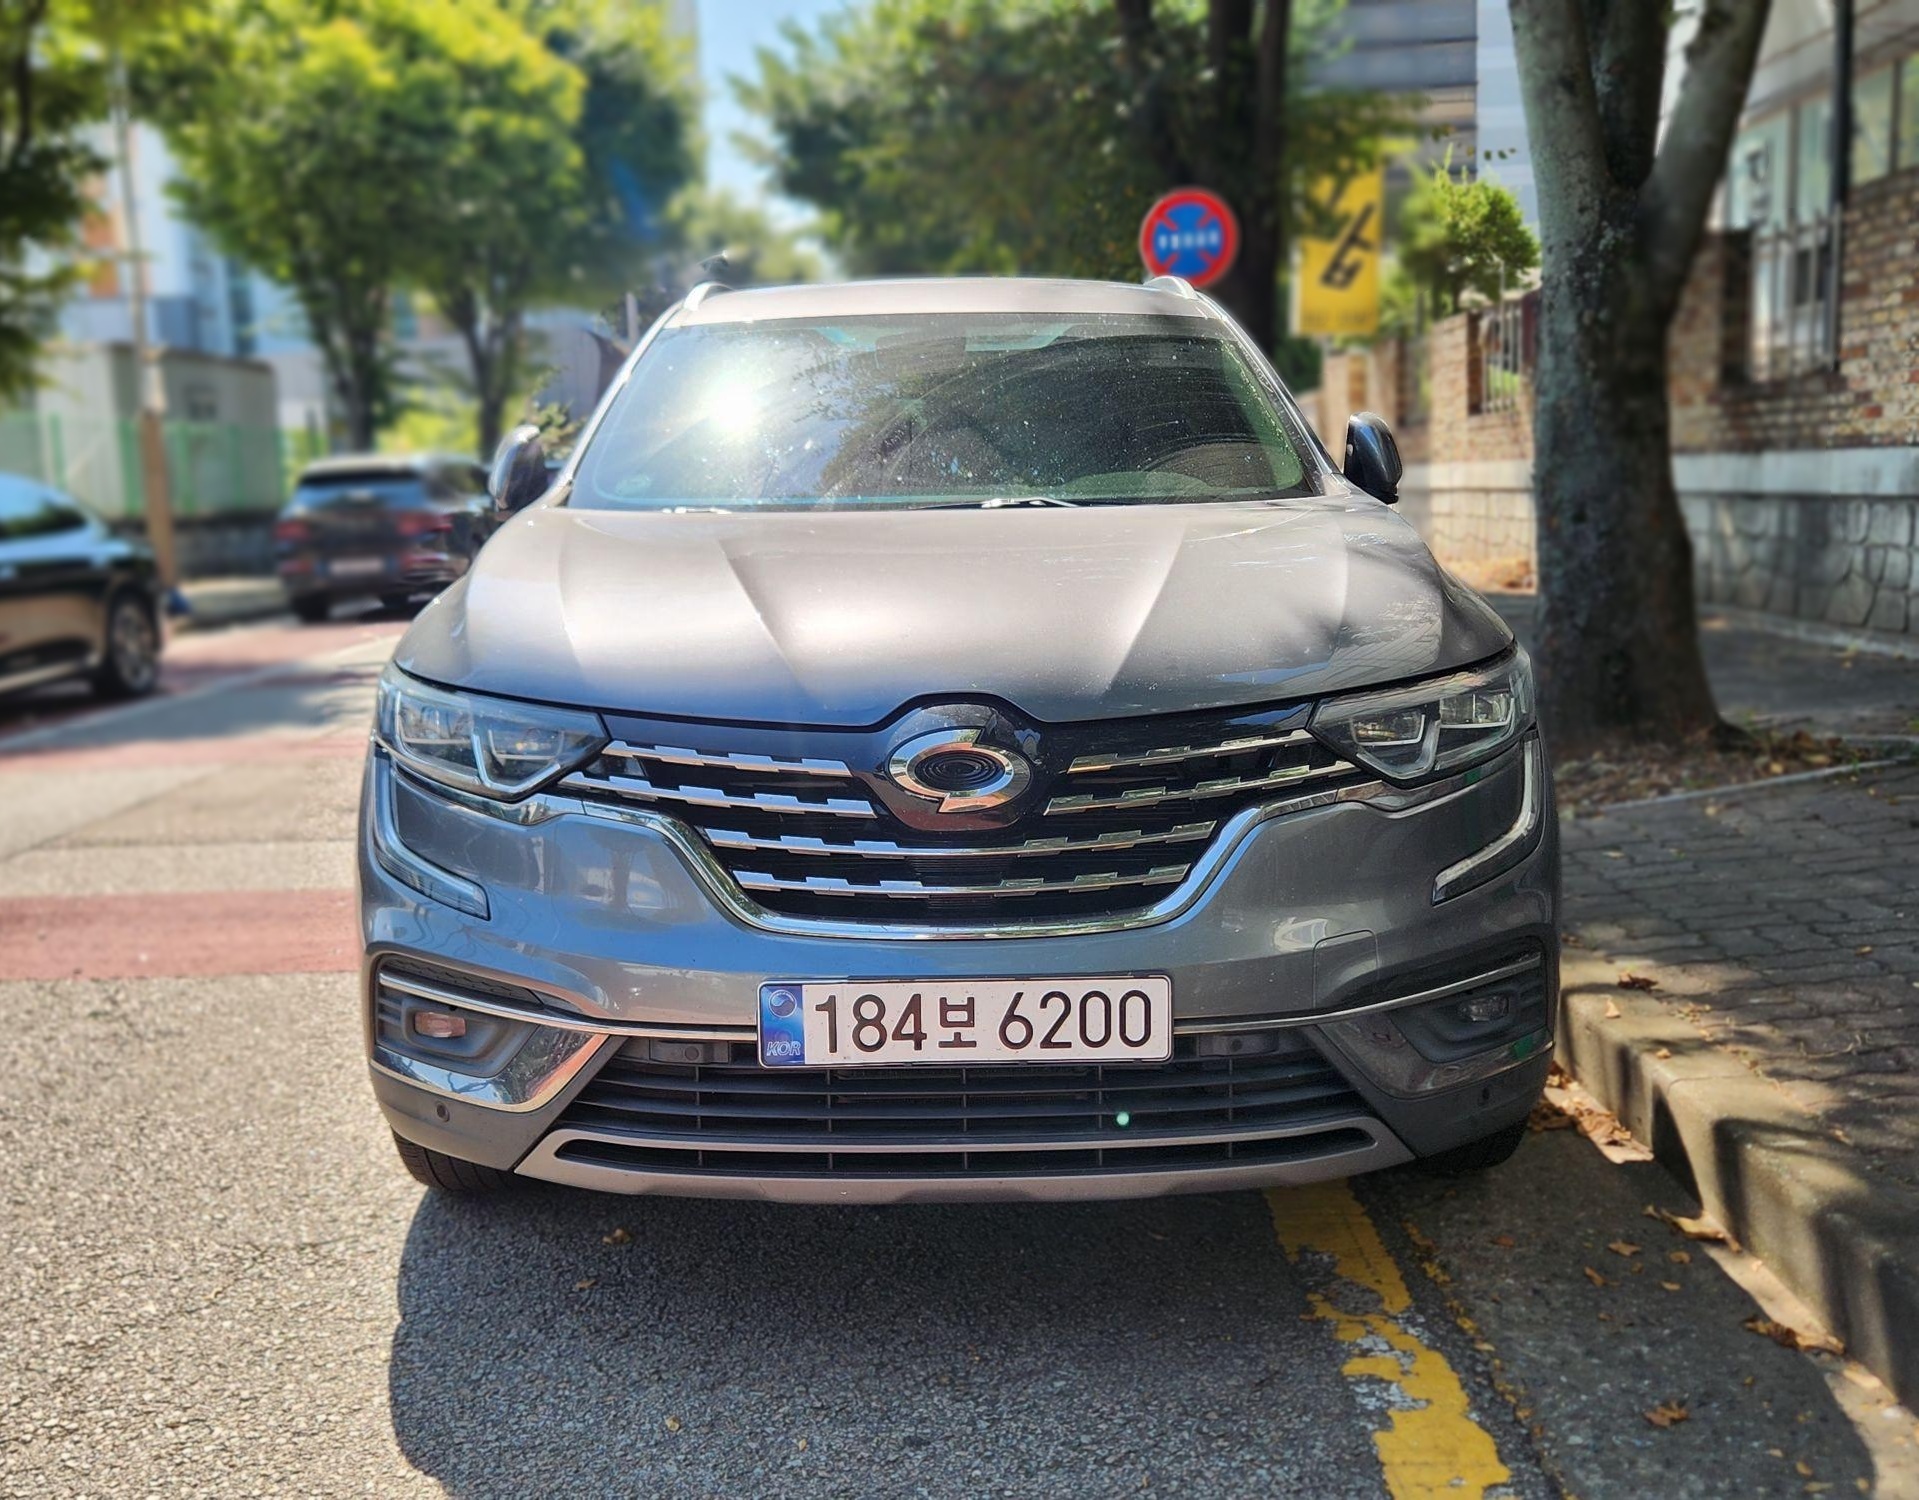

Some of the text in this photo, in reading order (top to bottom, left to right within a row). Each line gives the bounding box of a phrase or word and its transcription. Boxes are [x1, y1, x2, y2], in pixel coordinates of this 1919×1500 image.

[814, 989, 1152, 1054] 184보 6200
[766, 1040, 802, 1057] KOR
